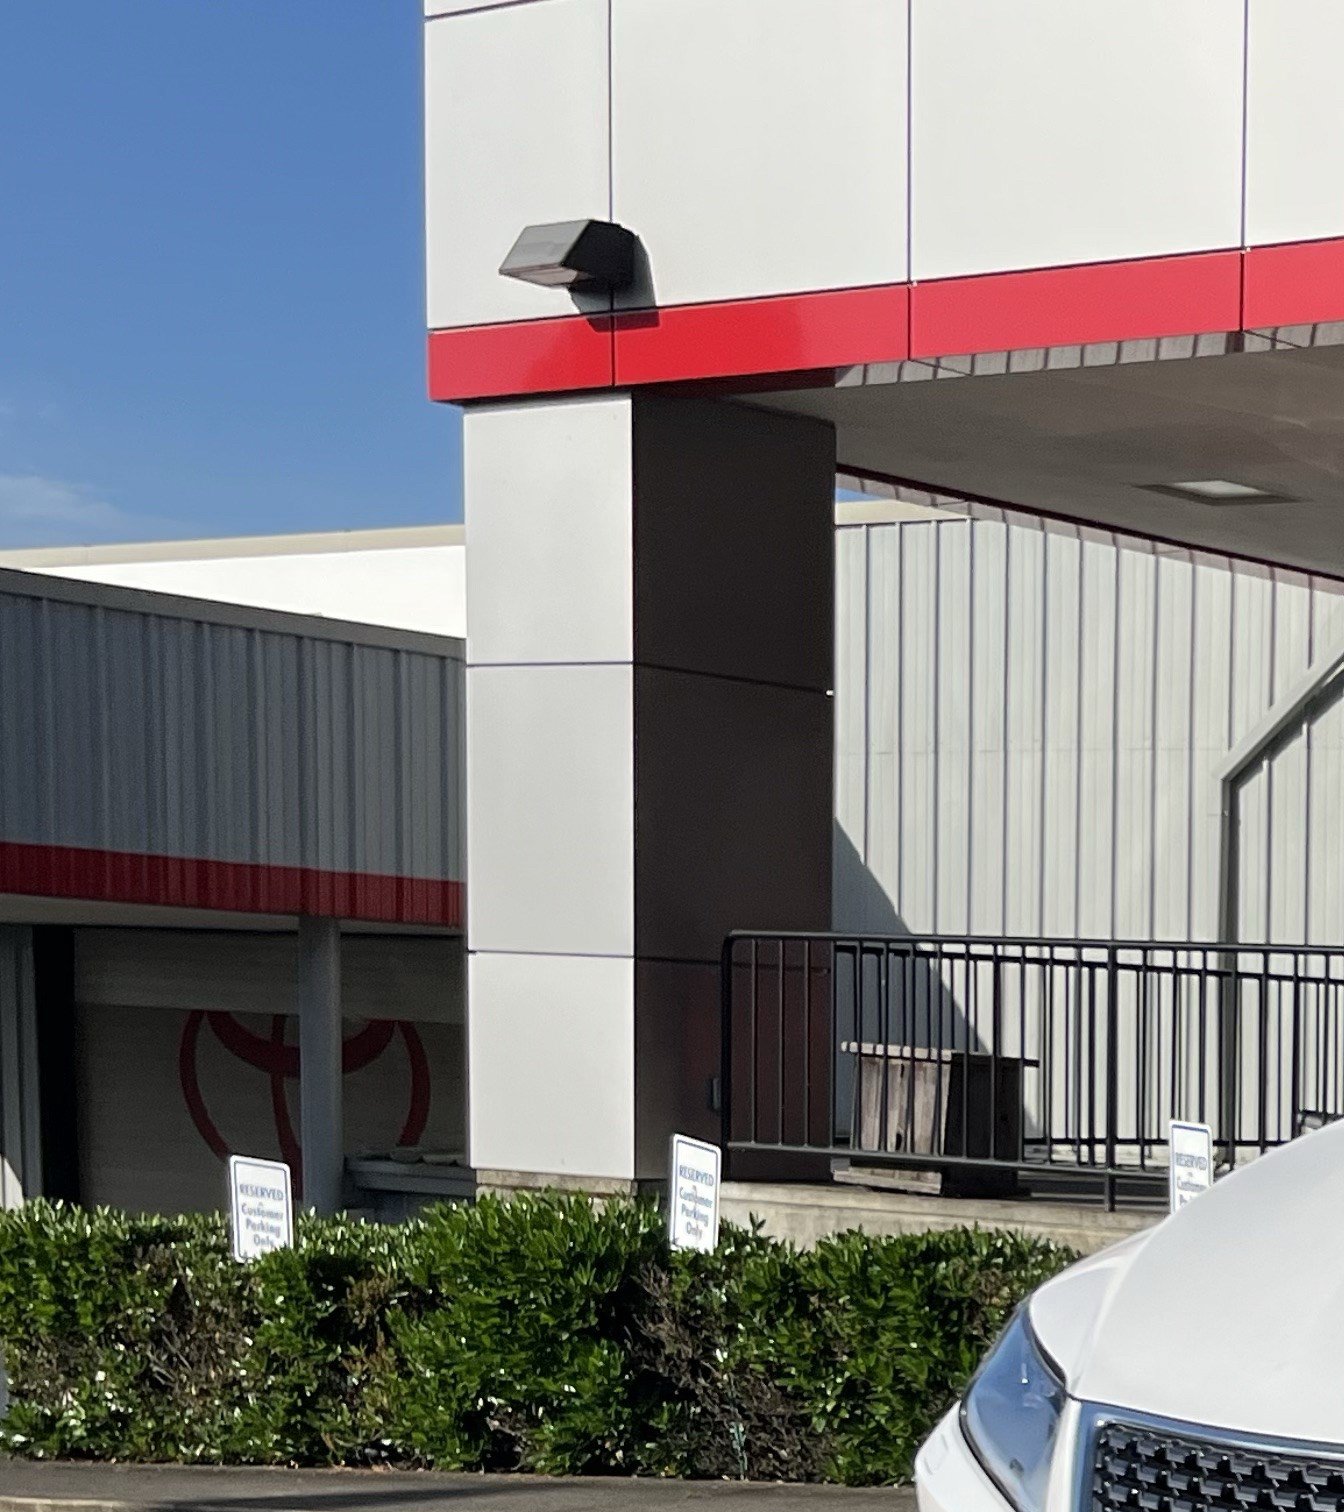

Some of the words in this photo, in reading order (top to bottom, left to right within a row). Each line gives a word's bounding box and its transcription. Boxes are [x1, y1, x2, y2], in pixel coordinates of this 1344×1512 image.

[680, 1165, 714, 1187] RESERVED
[240, 1184, 283, 1201] RESERVED
[680, 1186, 713, 1208] Customer
[241, 1202, 283, 1220] Customer
[681, 1203, 709, 1227] Parking
[246, 1218, 281, 1238] Parking
[686, 1221, 703, 1241] Only
